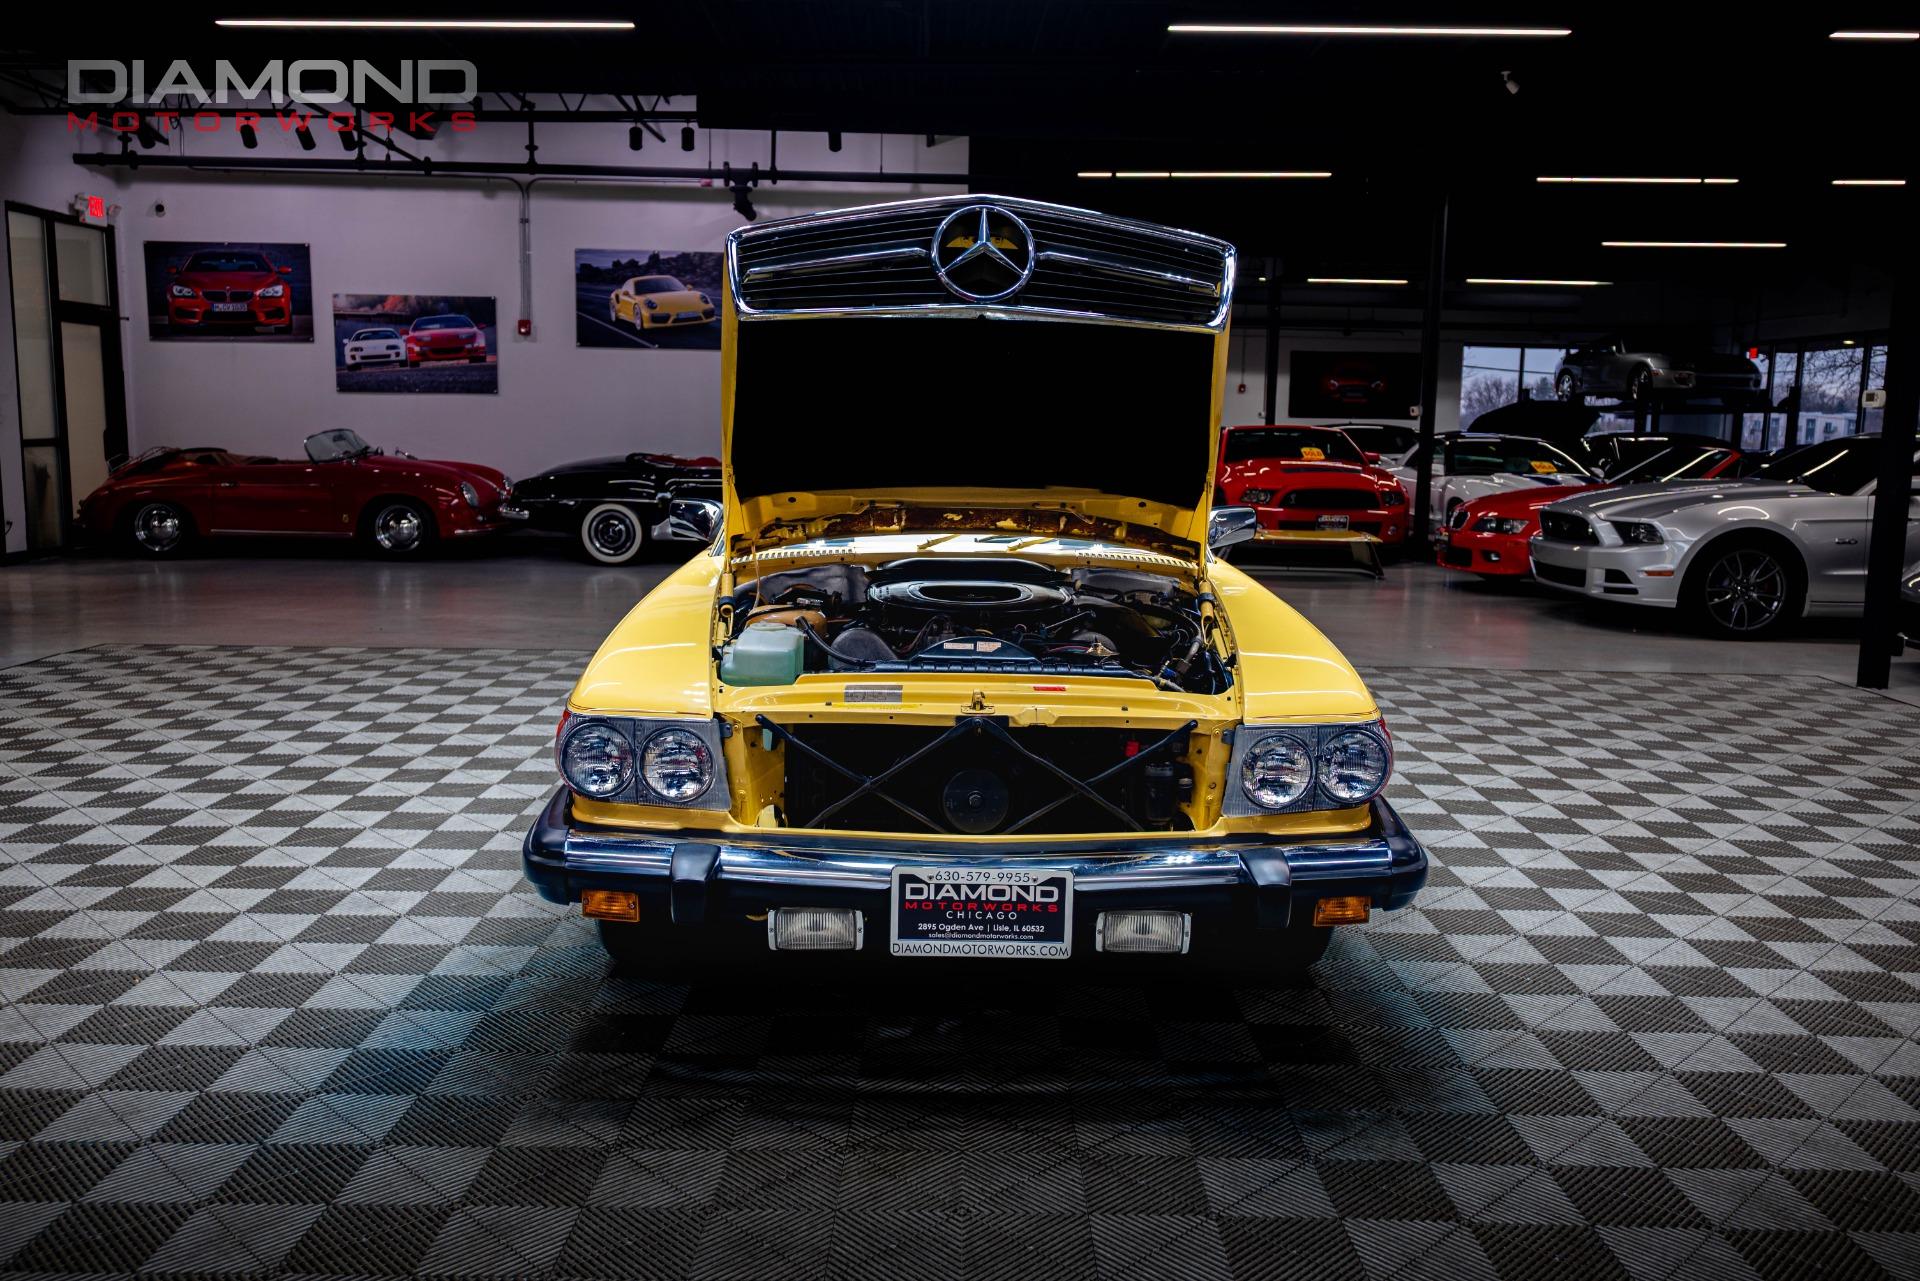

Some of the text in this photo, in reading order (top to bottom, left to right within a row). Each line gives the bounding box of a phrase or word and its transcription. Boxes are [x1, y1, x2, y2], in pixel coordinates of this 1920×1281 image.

[935, 871, 1031, 883] 630-579-9955
[905, 883, 1059, 902] DIAMOND
[905, 902, 1059, 912] MOTORWORKS
[946, 911, 1018, 920] CHICAGO
[917, 923, 937, 931] 2895
[938, 923, 966, 933] Ogden
[1021, 925, 1045, 933] 60532
[928, 932, 1034, 940] sales@diamondmotorworks.com
[892, 943, 1070, 957] DIAMONDMOTORWORKS.COM
